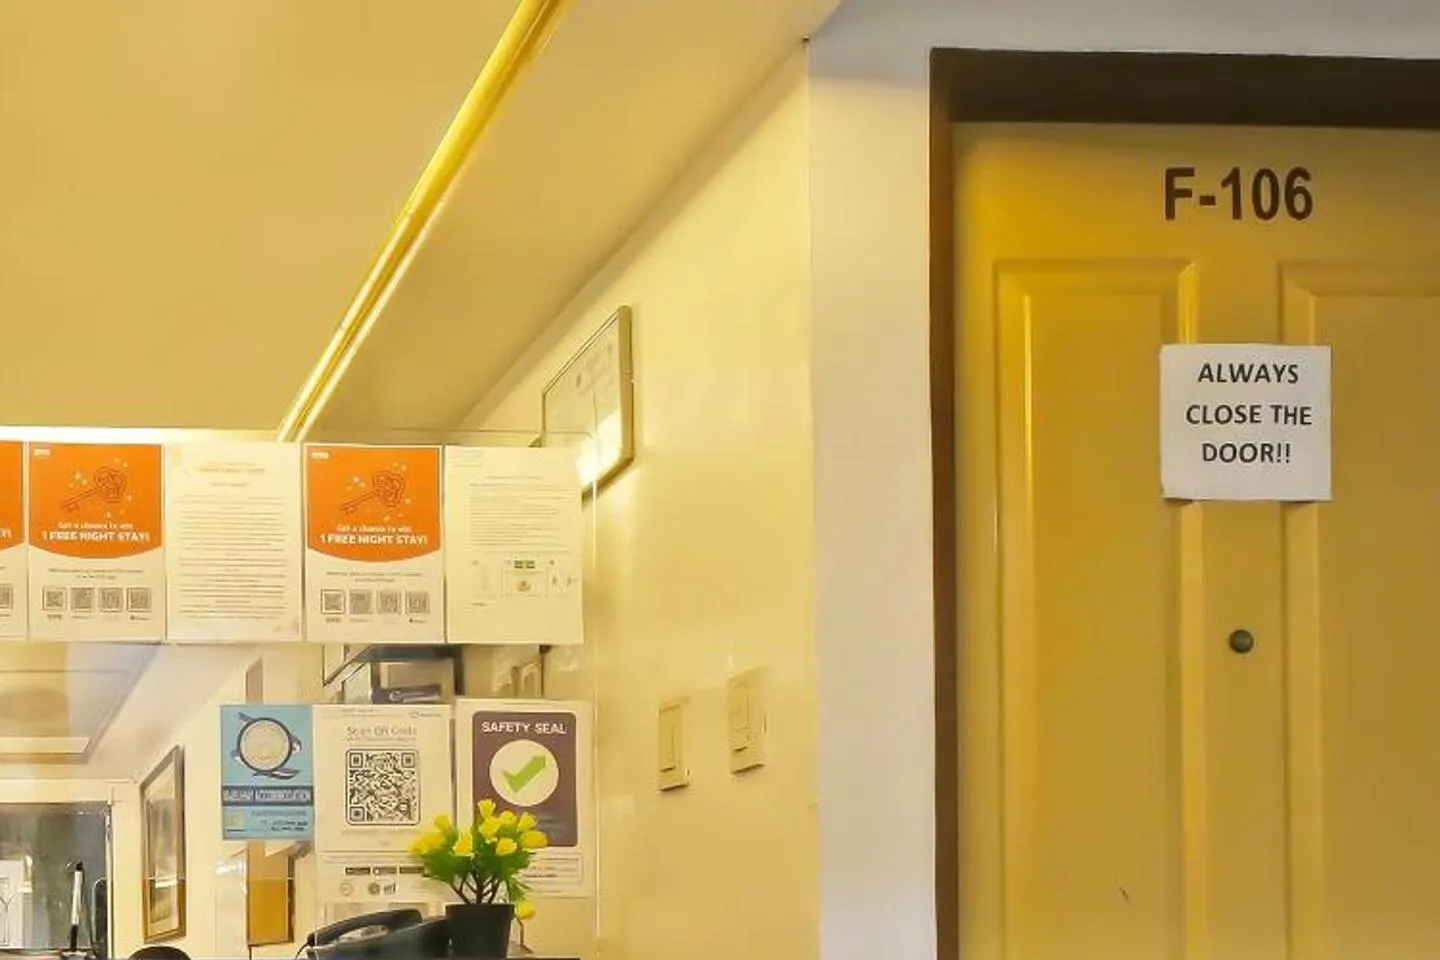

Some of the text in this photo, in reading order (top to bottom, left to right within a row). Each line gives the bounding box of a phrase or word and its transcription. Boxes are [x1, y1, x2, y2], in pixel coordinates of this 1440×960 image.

[1165, 167, 1313, 220] F-106
[1197, 363, 1299, 384] ALWAYS
[1186, 404, 1312, 425] CLOSE THE
[1202, 443, 1291, 464] DOOR!!
[42, 531, 151, 542] 1 FREE NIGHT STAY!
[320, 534, 428, 544] 1 FREE NIGHT STAY!
[481, 721, 567, 735] SAFETY SEAL
